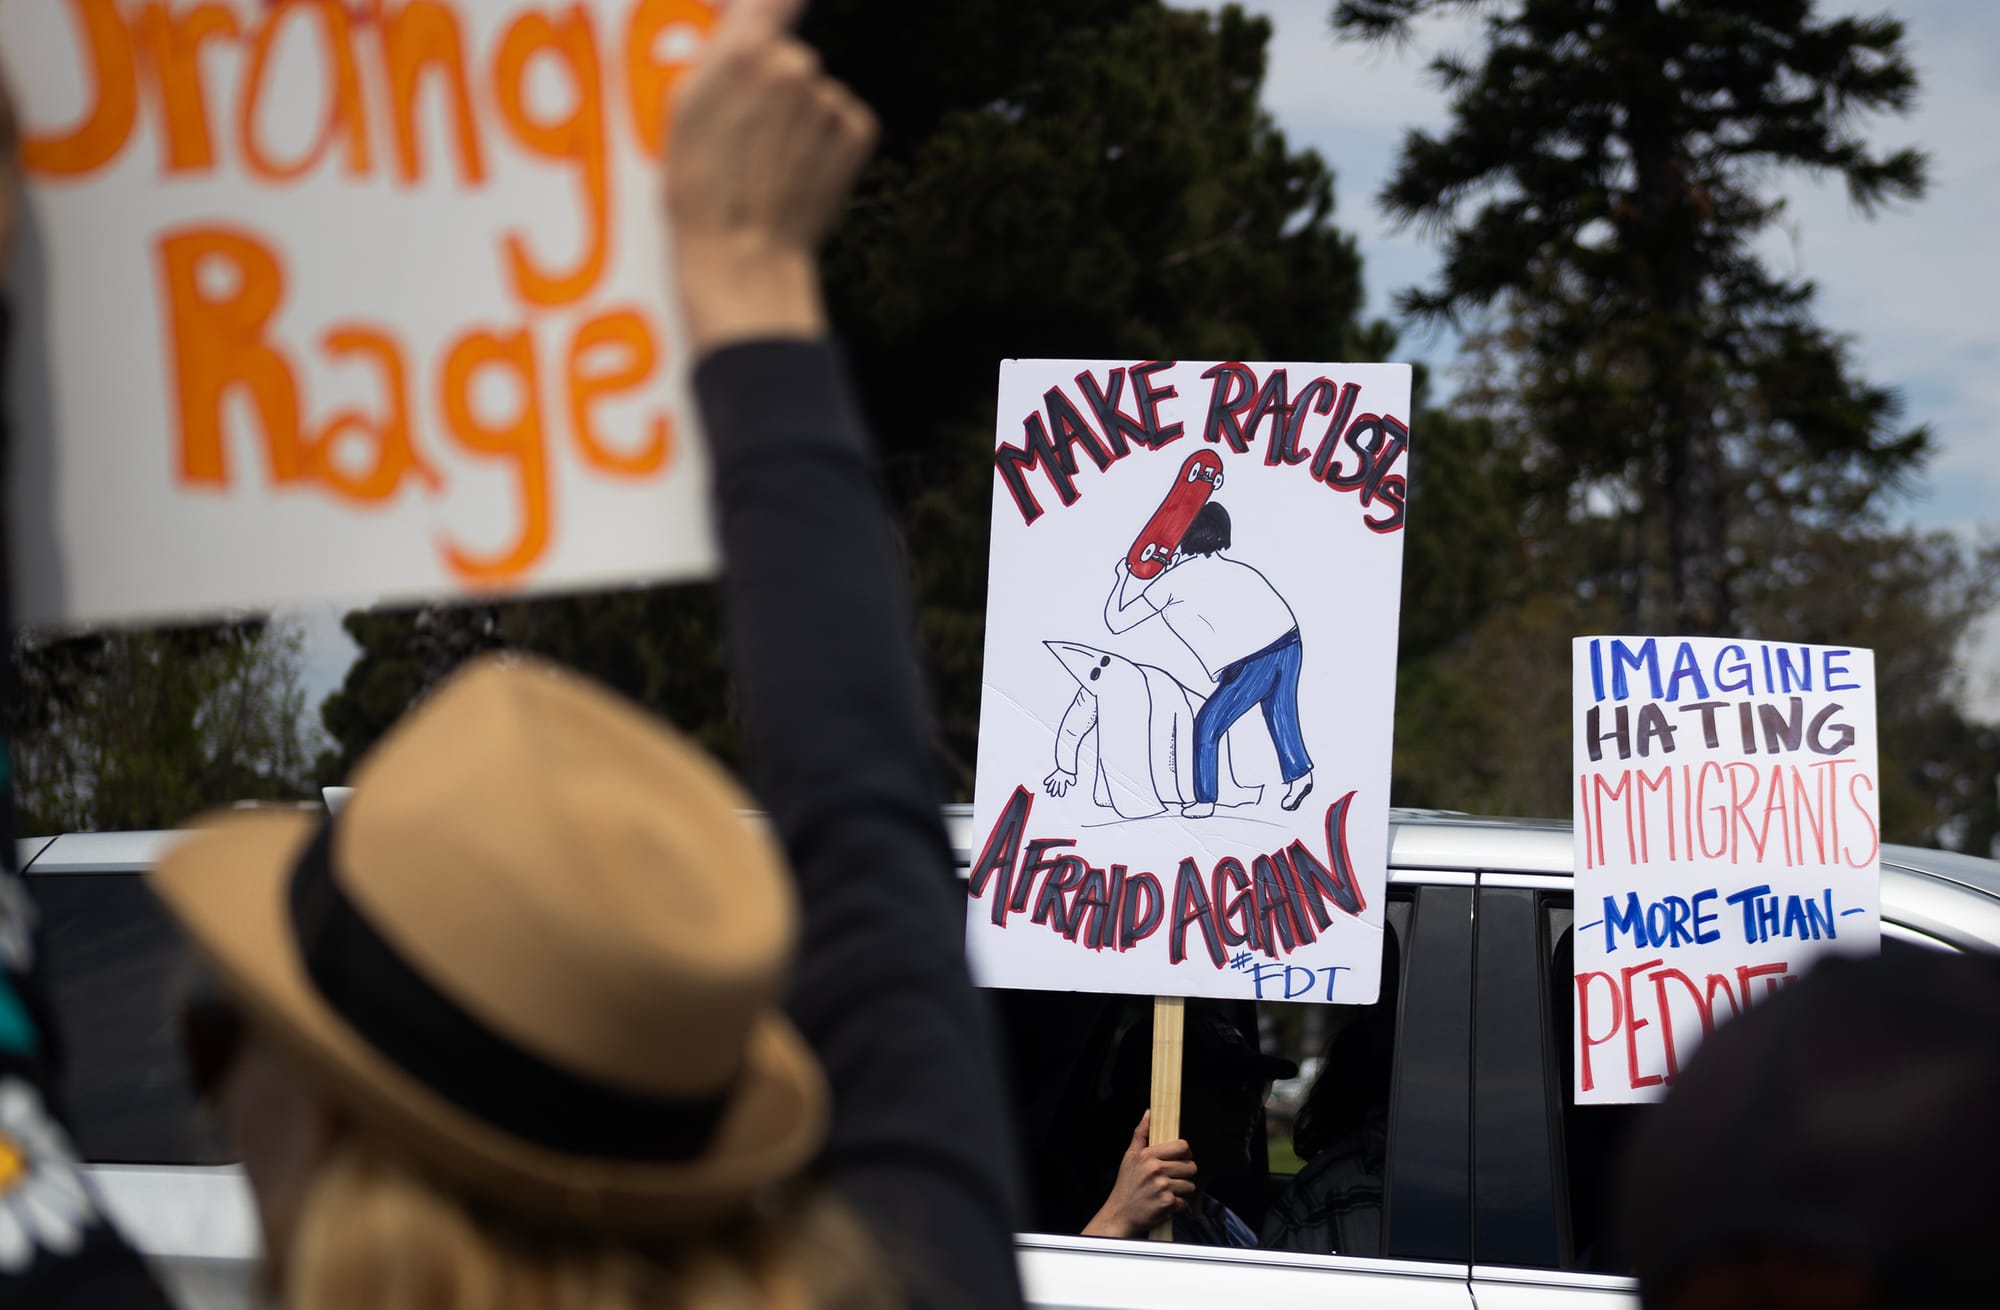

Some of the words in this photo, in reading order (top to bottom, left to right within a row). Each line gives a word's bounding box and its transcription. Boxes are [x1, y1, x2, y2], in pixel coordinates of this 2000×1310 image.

[154, 220, 678, 591] Rage
[995, 360, 1184, 526] MAKE
[1590, 637, 1861, 702] IMAGINE
[1586, 696, 1855, 762] HATING
[1580, 759, 1879, 869] IMMIGRANTS
[968, 784, 1164, 953] AFRAID
[1168, 790, 1367, 970] AGAIN
[1230, 950, 1351, 1001] #FDT
